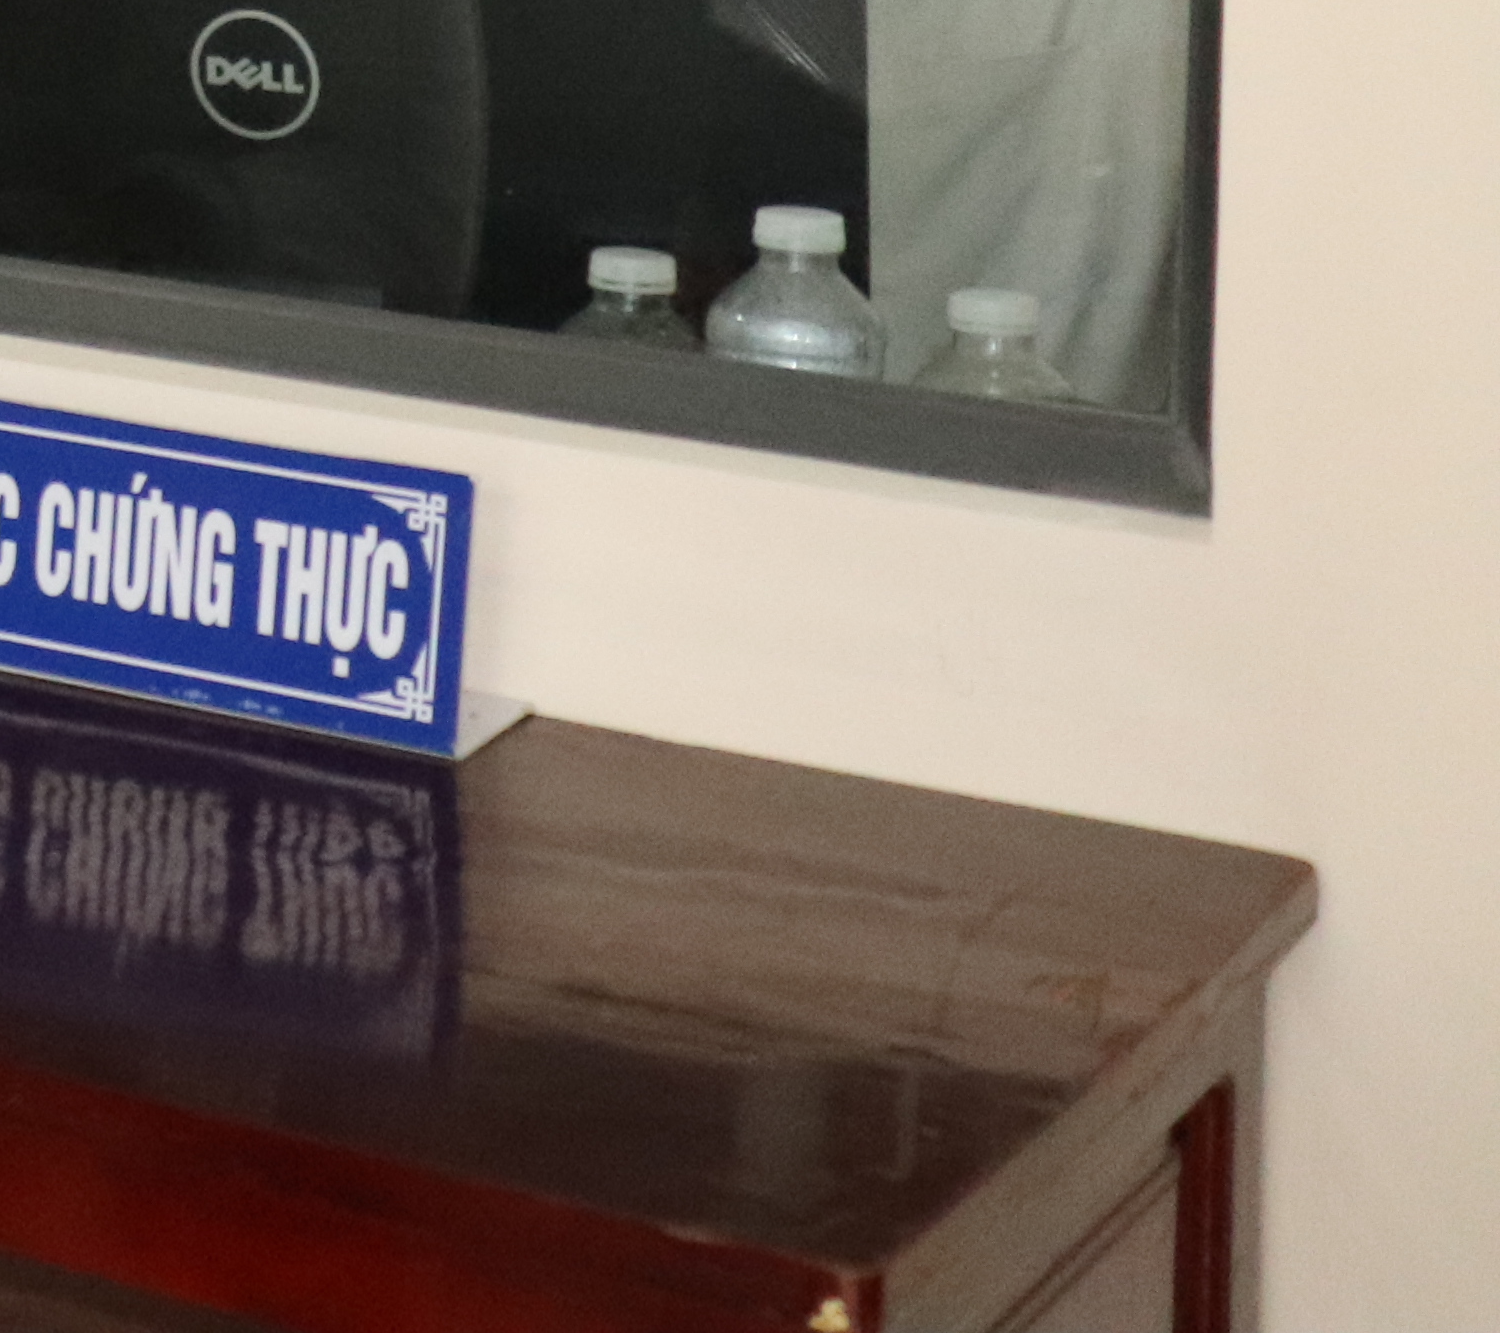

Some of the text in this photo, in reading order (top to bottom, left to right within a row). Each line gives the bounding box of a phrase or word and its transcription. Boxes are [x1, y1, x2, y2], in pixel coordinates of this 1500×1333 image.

[206, 56, 304, 94] DELL
[35, 473, 236, 628] CHỨNG
[255, 520, 409, 678] THỰC
